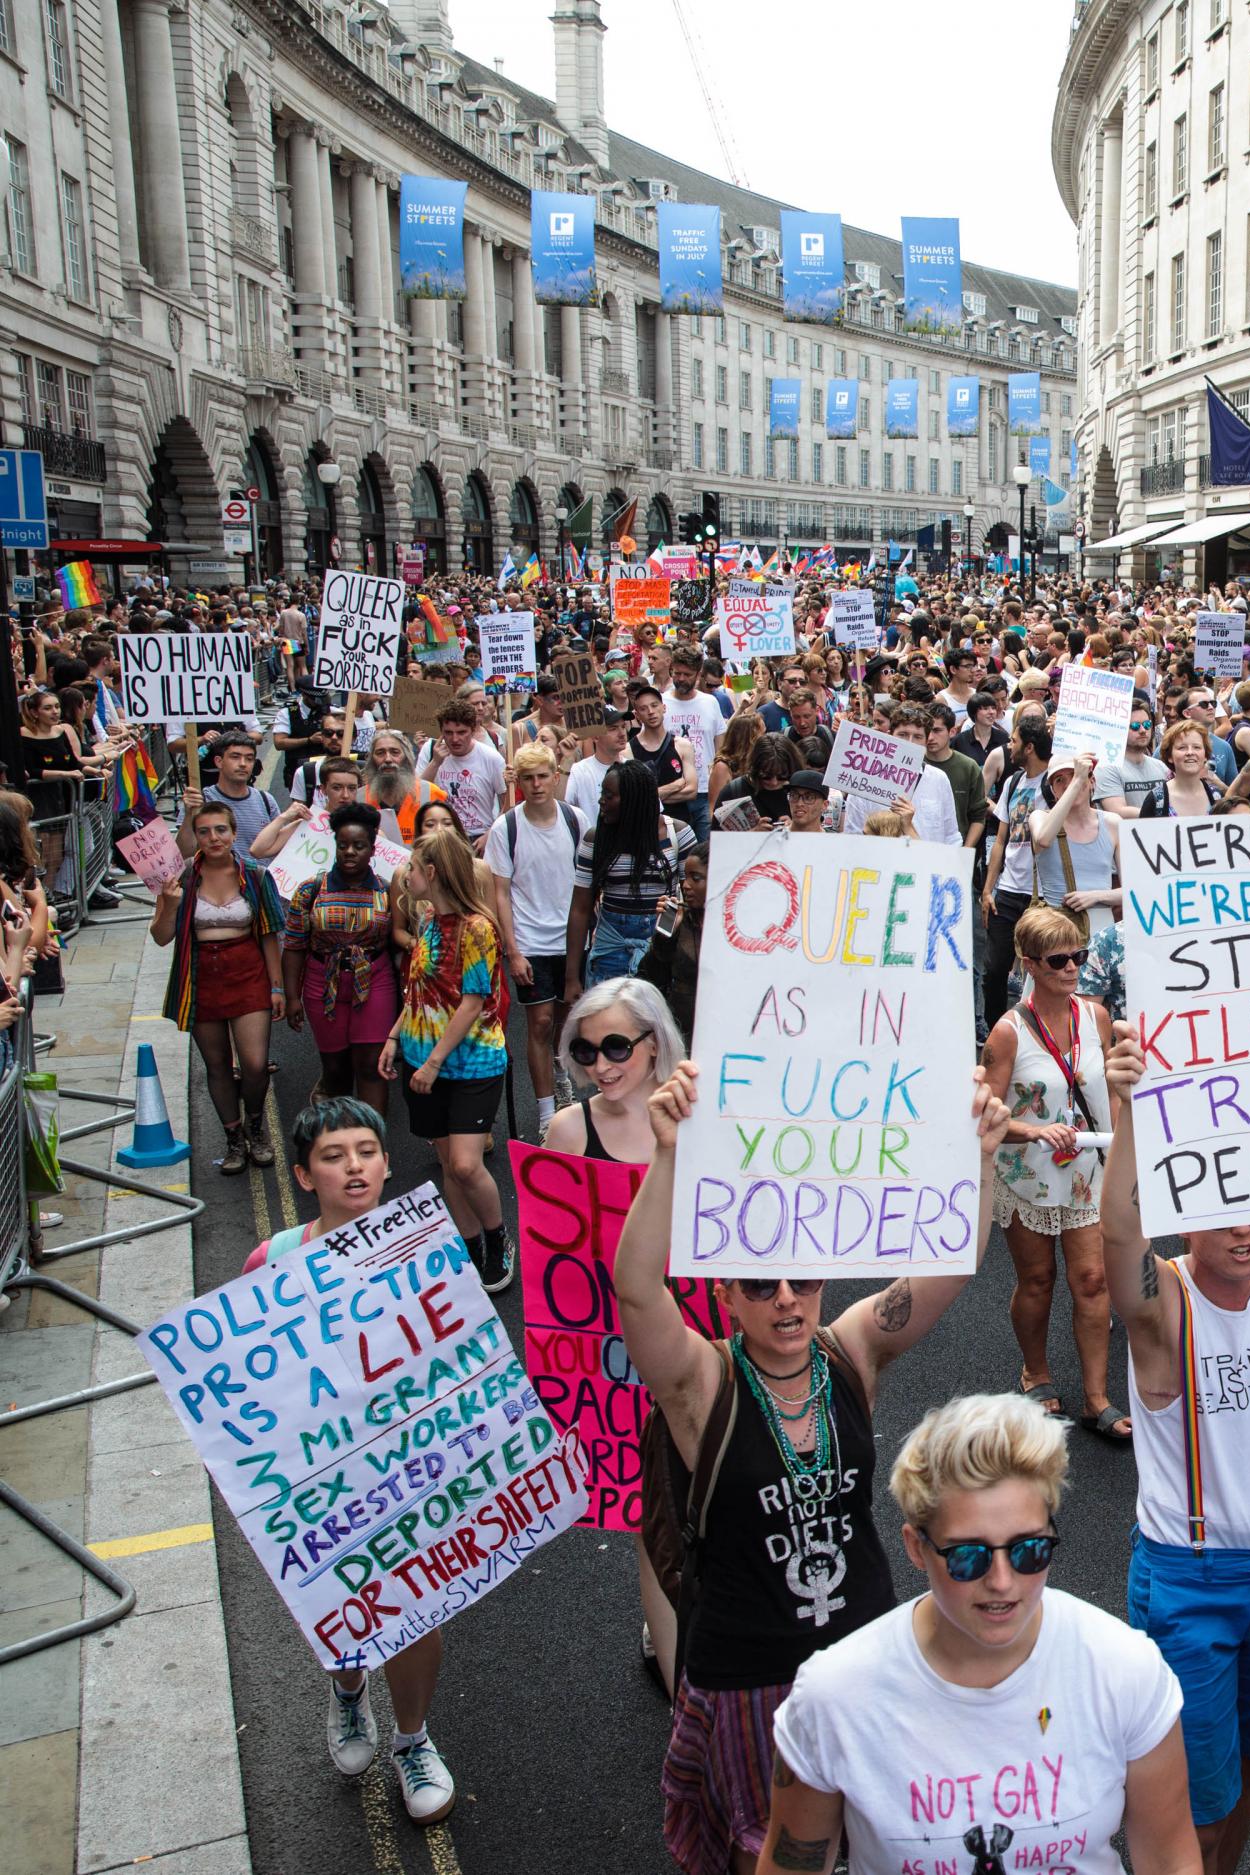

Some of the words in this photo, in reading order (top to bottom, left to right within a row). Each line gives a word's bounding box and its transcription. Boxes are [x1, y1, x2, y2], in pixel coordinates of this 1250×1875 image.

[406, 203, 456, 215] SUMMER
[406, 215, 456, 226] STREETS
[670, 244, 709, 252] SUNDAYS
[672, 229, 706, 237] TRAFFIC
[908, 244, 955, 255] SUMMER
[909, 255, 955, 265] STREETS
[326, 574, 401, 622] QUEER
[723, 598, 773, 612] EQUAL
[835, 613, 874, 623] Immigration
[846, 605, 862, 613] STOP
[321, 625, 398, 658] FUCK
[339, 613, 356, 628] as
[359, 615, 371, 631] in
[488, 634, 503, 643] Tear
[503, 633, 524, 642] down
[121, 636, 163, 673] NO
[169, 635, 251, 673] HUMAN
[341, 650, 368, 664] YOUR
[488, 646, 500, 655] the
[491, 654, 509, 664] OPEN
[509, 653, 523, 662] THE
[749, 636, 792, 652] LOVER
[1197, 639, 1243, 648] Immigration
[315, 657, 394, 694] BORDERS
[492, 664, 524, 675] BORDERS
[125, 675, 149, 718] IS
[161, 675, 255, 717] ILLEGAL
[1060, 687, 1130, 720] BARCLAYS
[848, 728, 899, 759] PRIDE
[901, 754, 914, 766] IN
[723, 860, 969, 973] QUEER
[751, 986, 806, 1039] AS
[858, 989, 907, 1045] IN
[718, 1052, 926, 1126] FUCK
[736, 1125, 911, 1179] YOUR
[325, 1193, 448, 1258] #FreeHer
[691, 1176, 977, 1262] BORDERS
[147, 1248, 346, 1376] POLICE
[178, 1234, 473, 1424] PROTECTION
[221, 1401, 280, 1447] IS
[307, 1365, 339, 1408] A
[357, 1281, 466, 1384] LIE
[525, 1327, 600, 1377] YOU
[235, 1450, 296, 1512] 3
[298, 1316, 501, 1465] MIGRANT
[265, 1472, 356, 1545] SEX
[364, 1359, 526, 1474] WORKERS
[280, 1450, 448, 1581] ARRESTED
[446, 1422, 492, 1460] TO
[501, 1386, 539, 1426] BE
[758, 1468, 860, 1515] RIOTS
[332, 1415, 555, 1596] DEPORTED
[312, 1578, 403, 1660] FOR
[391, 1525, 489, 1602] THEIR
[481, 1425, 589, 1549] SAFETY?
[765, 1513, 854, 1563] DIETS
[333, 1511, 558, 1672] #TwitterSWARM
[910, 1774, 983, 1824] NOT
[993, 1753, 1063, 1822] GAY
[901, 1858, 926, 1875] AS
[935, 1858, 958, 1875] IN
[1014, 1829, 1088, 1870] HAPPY
